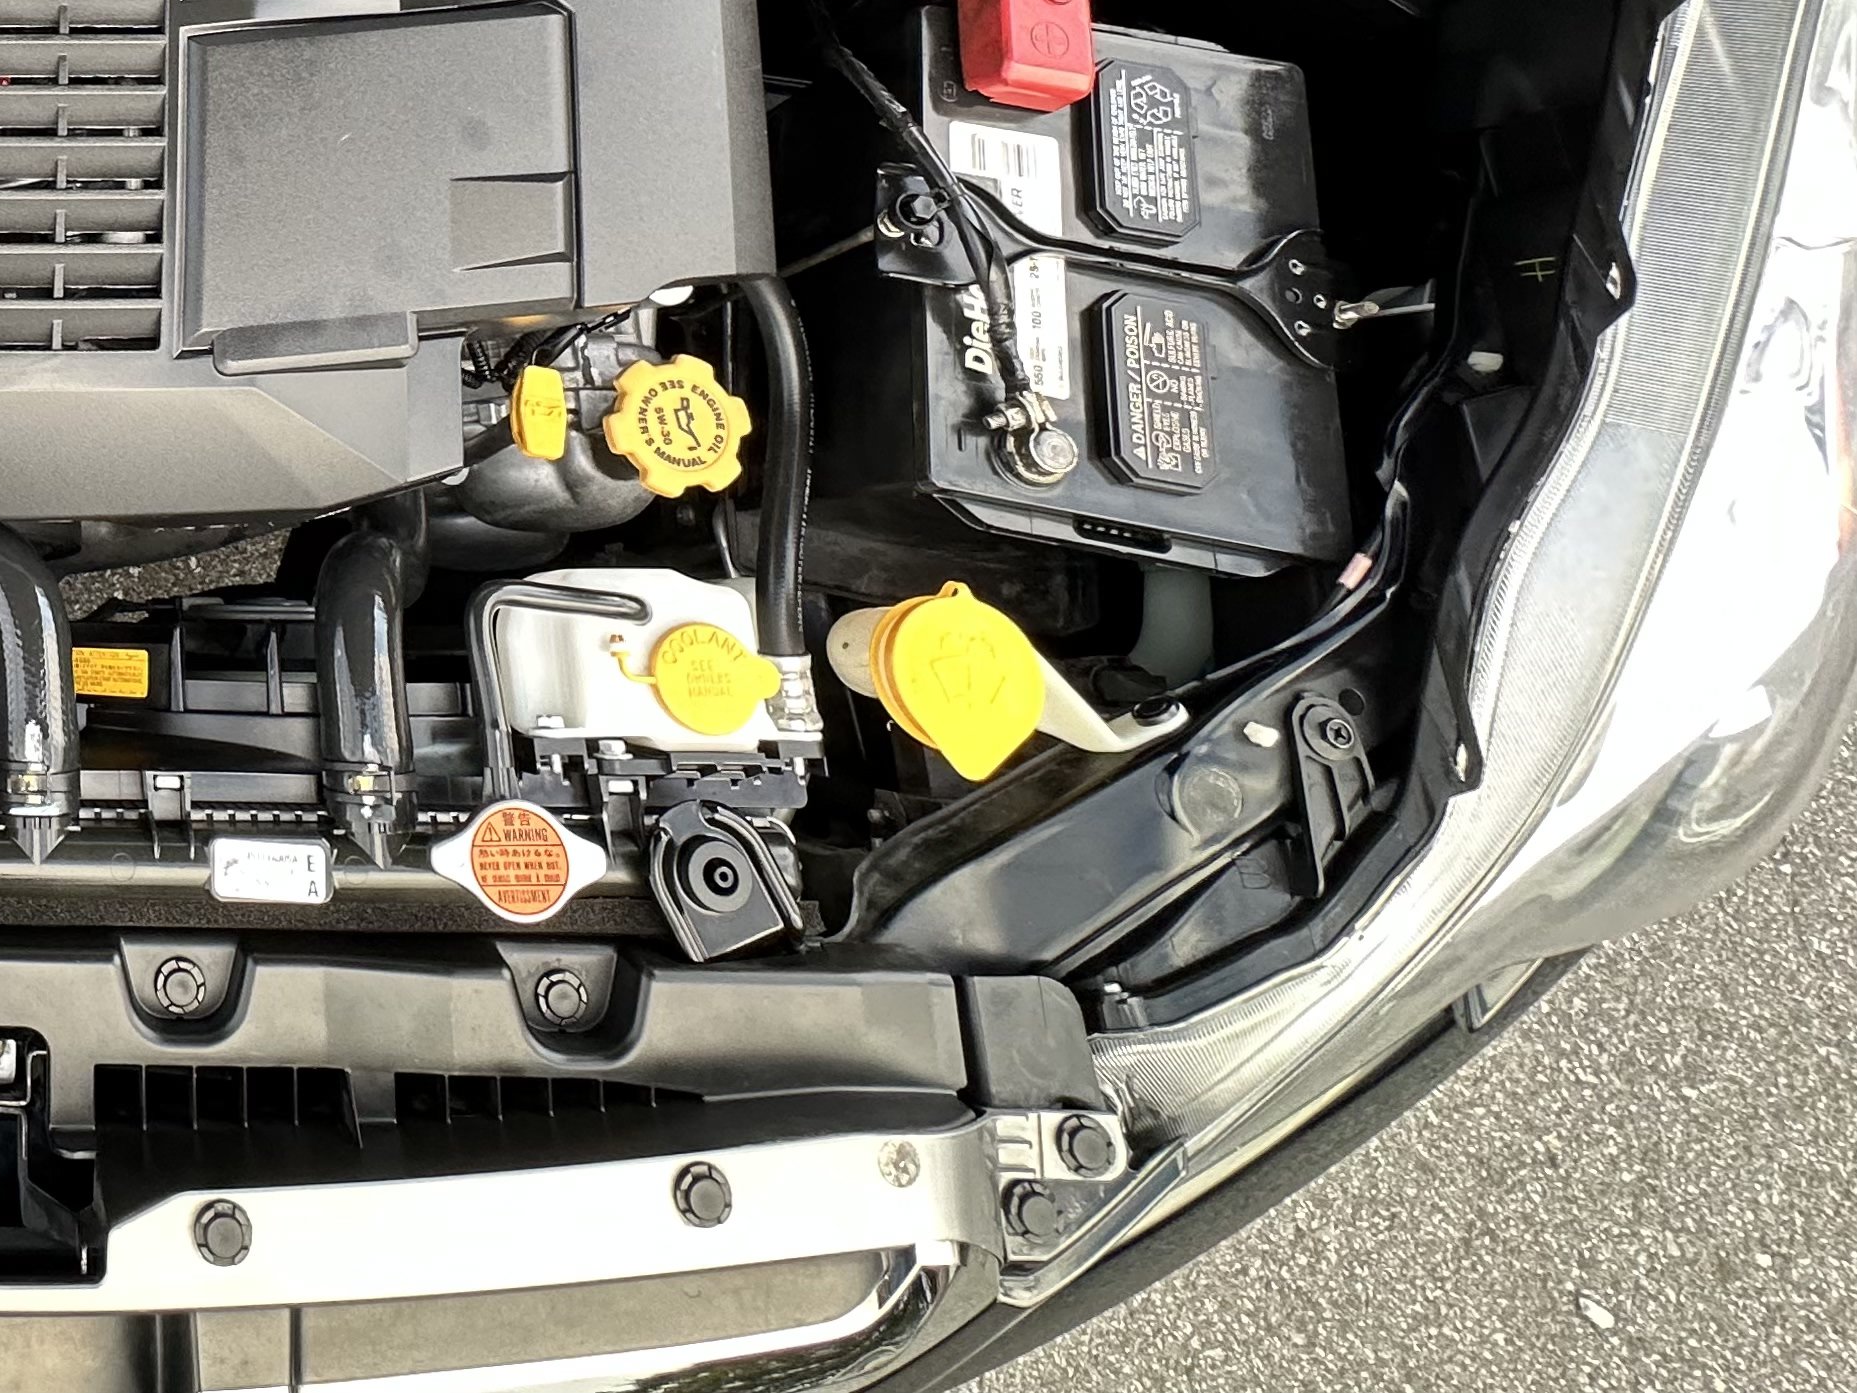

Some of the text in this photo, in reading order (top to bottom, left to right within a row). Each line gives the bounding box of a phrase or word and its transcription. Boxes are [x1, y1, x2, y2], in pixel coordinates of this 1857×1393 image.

[1031, 311, 1041, 329] 100
[962, 284, 992, 375] DieH
[1123, 313, 1139, 368] POISON
[1169, 379, 1178, 393] NO
[691, 384, 726, 455] ENGINE OIL
[1129, 383, 1145, 445] DANGER
[638, 379, 707, 468] SEE OWNER'S MANUAL
[662, 628, 744, 665] COOLANT
[502, 812, 531, 826] 警告
[503, 828, 548, 842] WARNING
[307, 854, 316, 872] E
[503, 861, 521, 871] OPEN
[524, 861, 543, 871] WHEN
[308, 880, 318, 897] A
